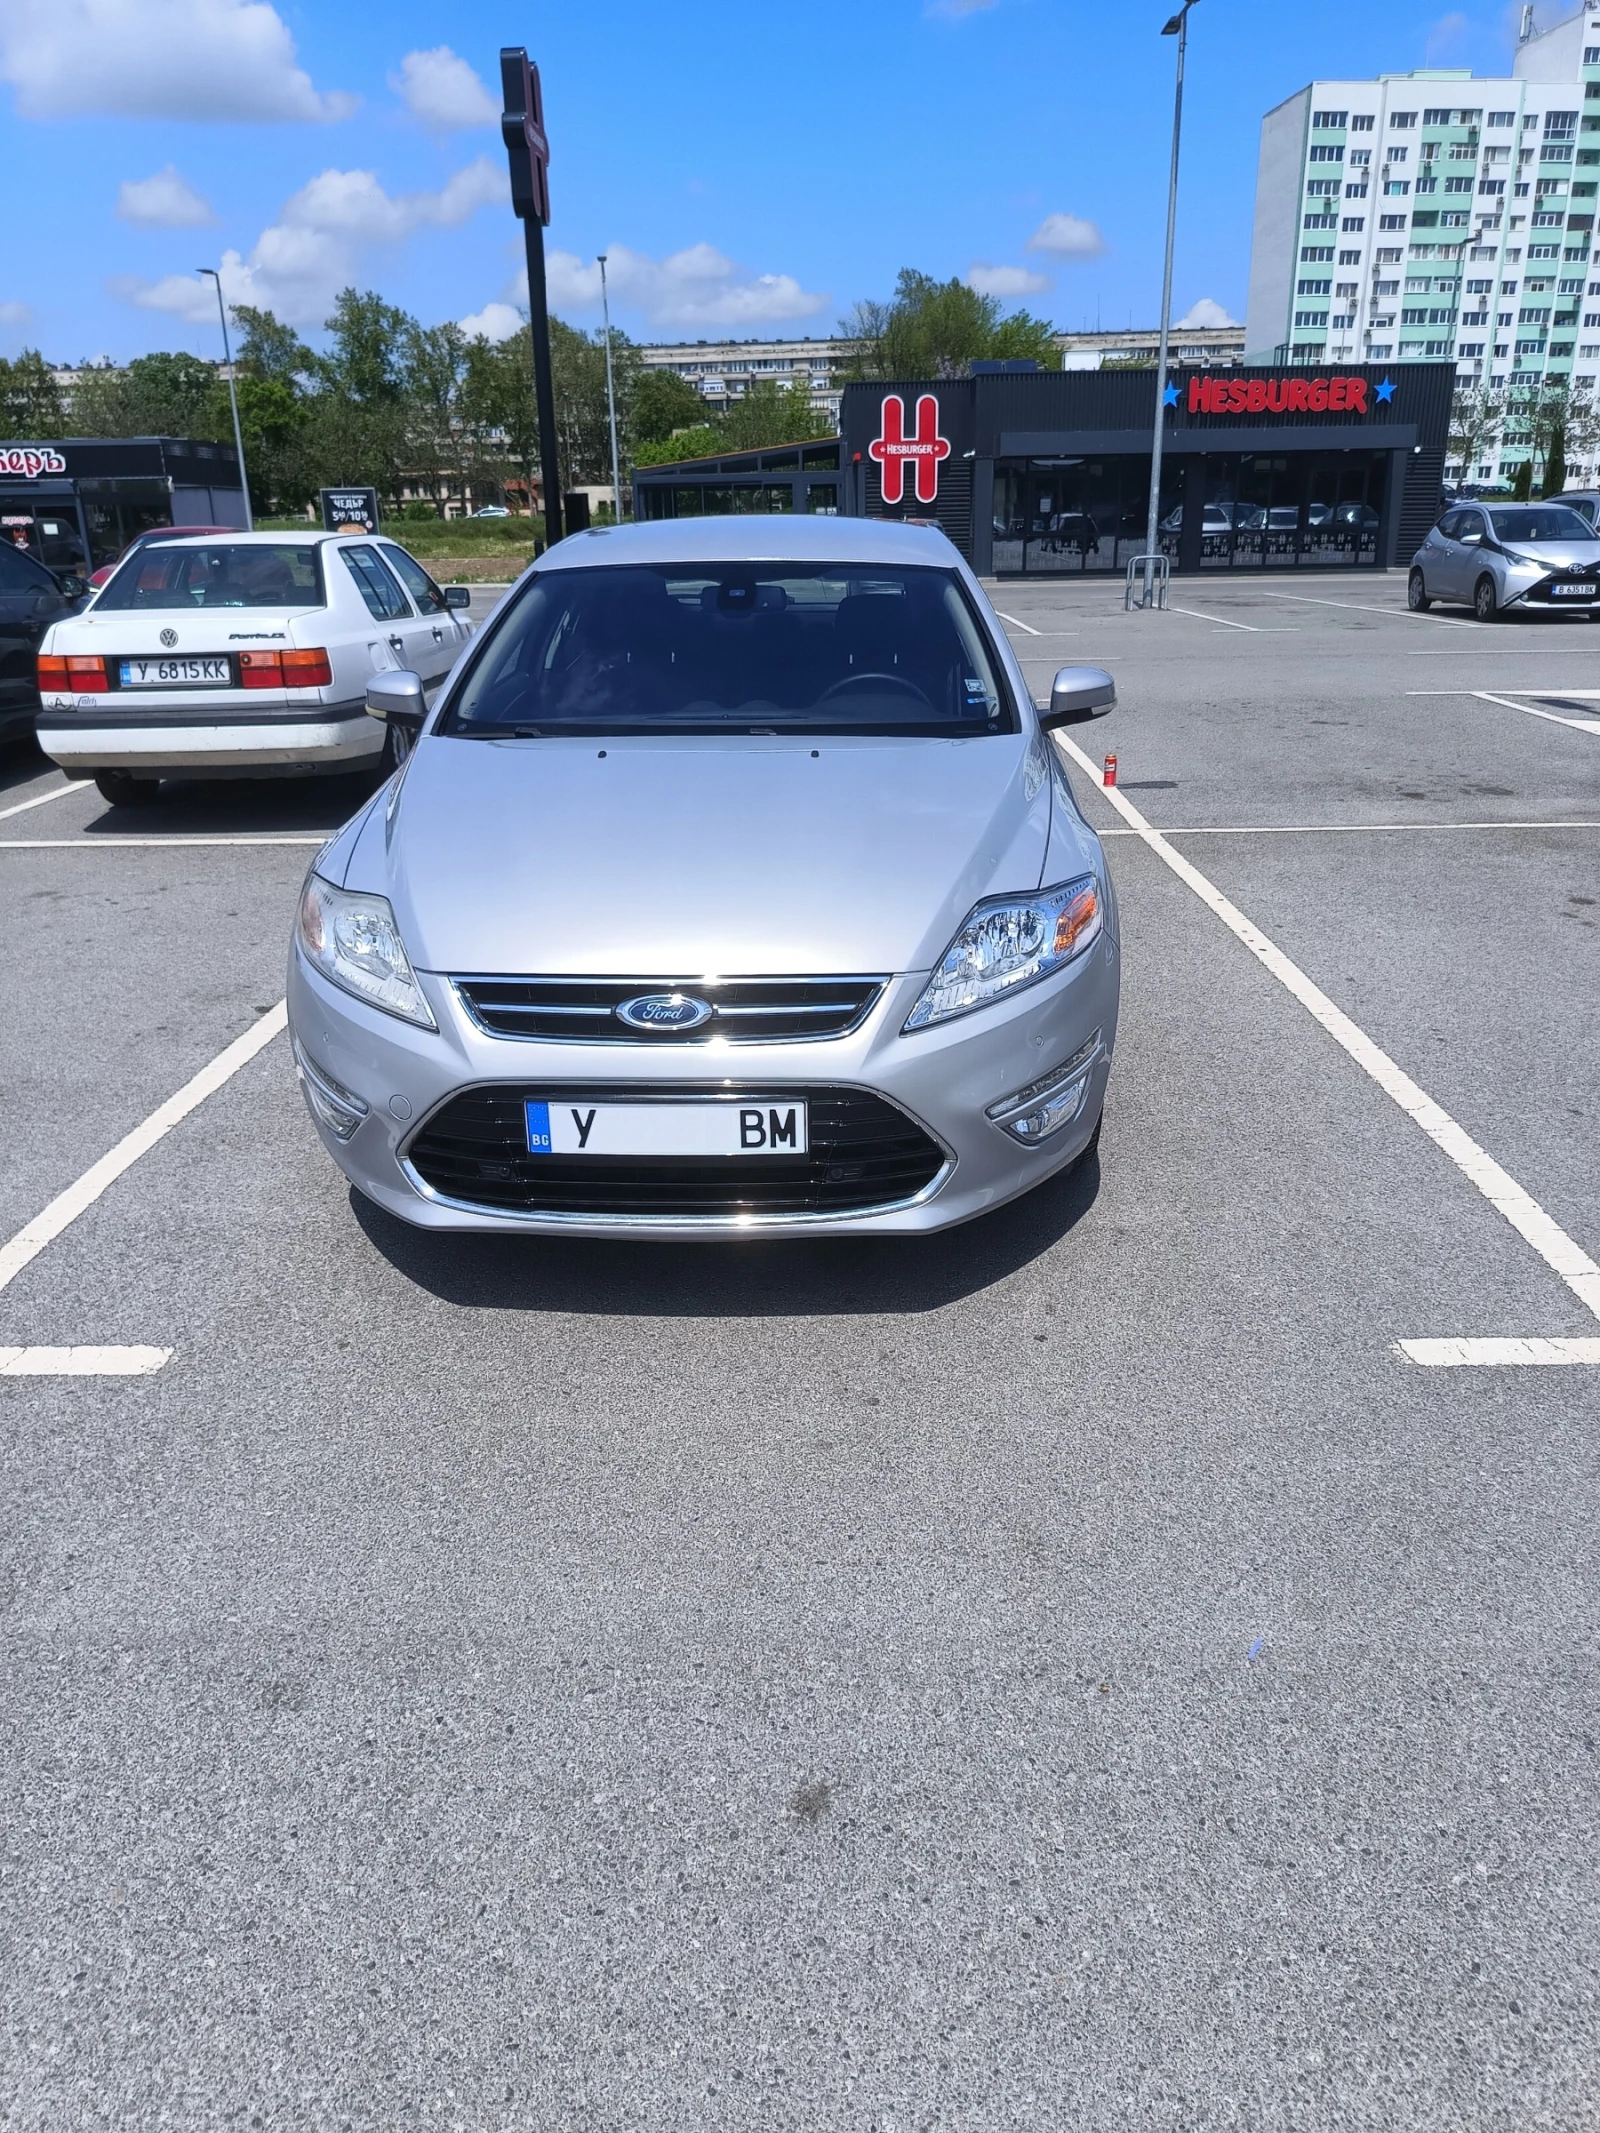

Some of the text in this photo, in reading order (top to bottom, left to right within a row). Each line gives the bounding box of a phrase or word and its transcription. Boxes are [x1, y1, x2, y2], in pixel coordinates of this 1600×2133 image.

[1188, 376, 1368, 414] HESBURGER
[886, 444, 933, 455] HESBURGER
[642, 1002, 685, 1020] Ford
[740, 1109, 796, 1148] BM
[532, 1133, 549, 1147] BG
